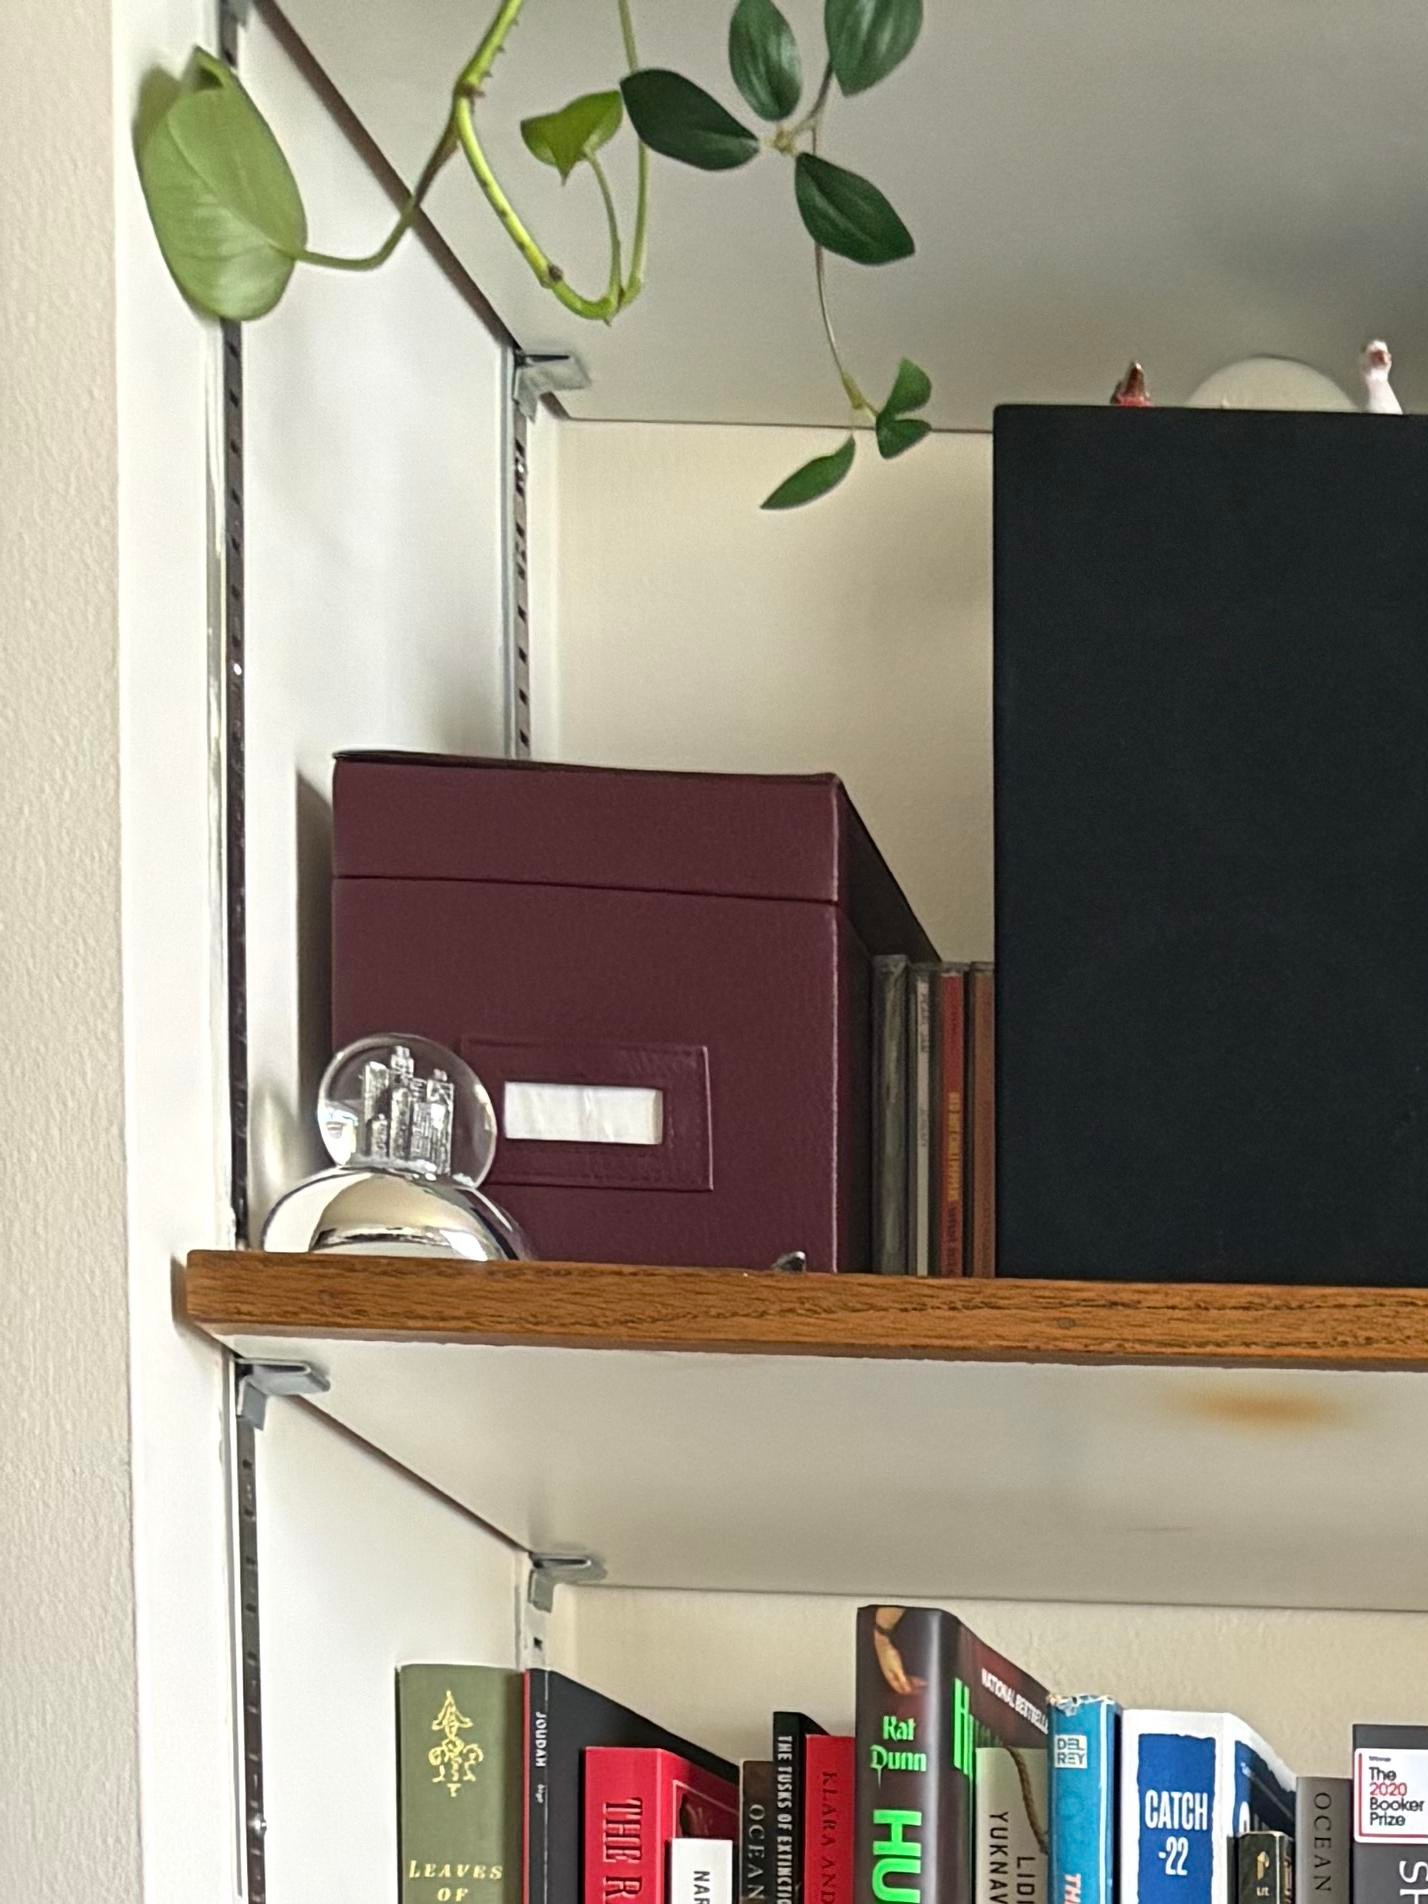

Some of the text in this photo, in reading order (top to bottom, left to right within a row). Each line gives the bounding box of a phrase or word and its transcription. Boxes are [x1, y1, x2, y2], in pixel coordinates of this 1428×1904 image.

[1368, 1766, 1397, 1782] The
[1368, 1782, 1408, 1797] 2020
[1145, 1790, 1208, 1832] CATCH
[1369, 1797, 1425, 1813] Booker
[1369, 1811, 1406, 1829] Prize
[1158, 1837, 1189, 1877] -22
[436, 1885, 468, 1904] OF
